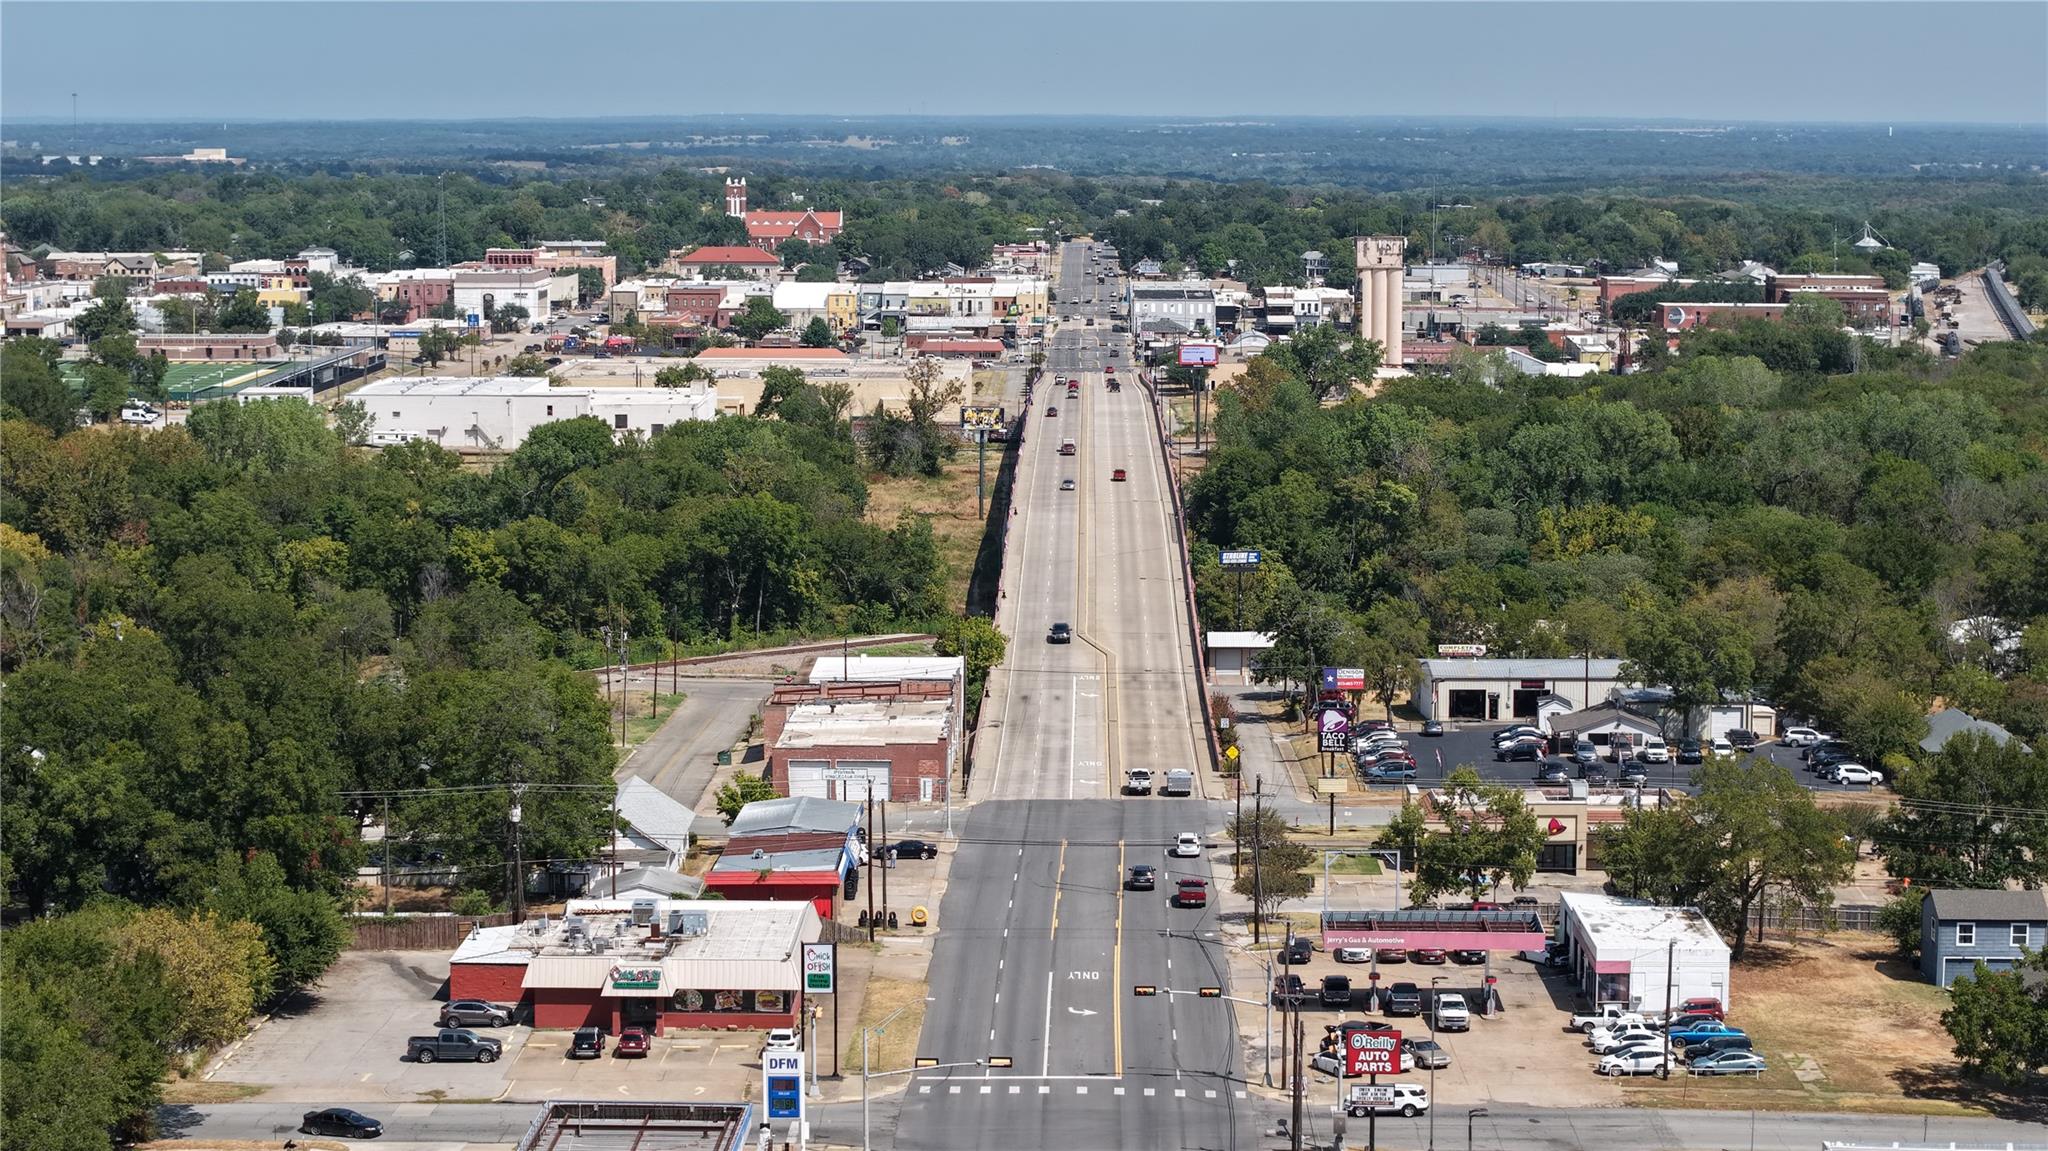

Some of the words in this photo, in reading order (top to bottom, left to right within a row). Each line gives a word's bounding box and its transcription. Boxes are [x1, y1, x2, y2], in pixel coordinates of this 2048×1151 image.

[1321, 732, 1345, 740] TACO
[1322, 739, 1345, 747] BELL
[1327, 937, 1348, 945] Jerry's
[1367, 936, 1404, 944] Automotive
[1067, 971, 1099, 980] ONLY
[1352, 1034, 1395, 1050] O'Reilly
[1358, 1051, 1389, 1061] AUTO
[769, 1058, 798, 1070] DFM
[1355, 1062, 1392, 1072] PARTS
